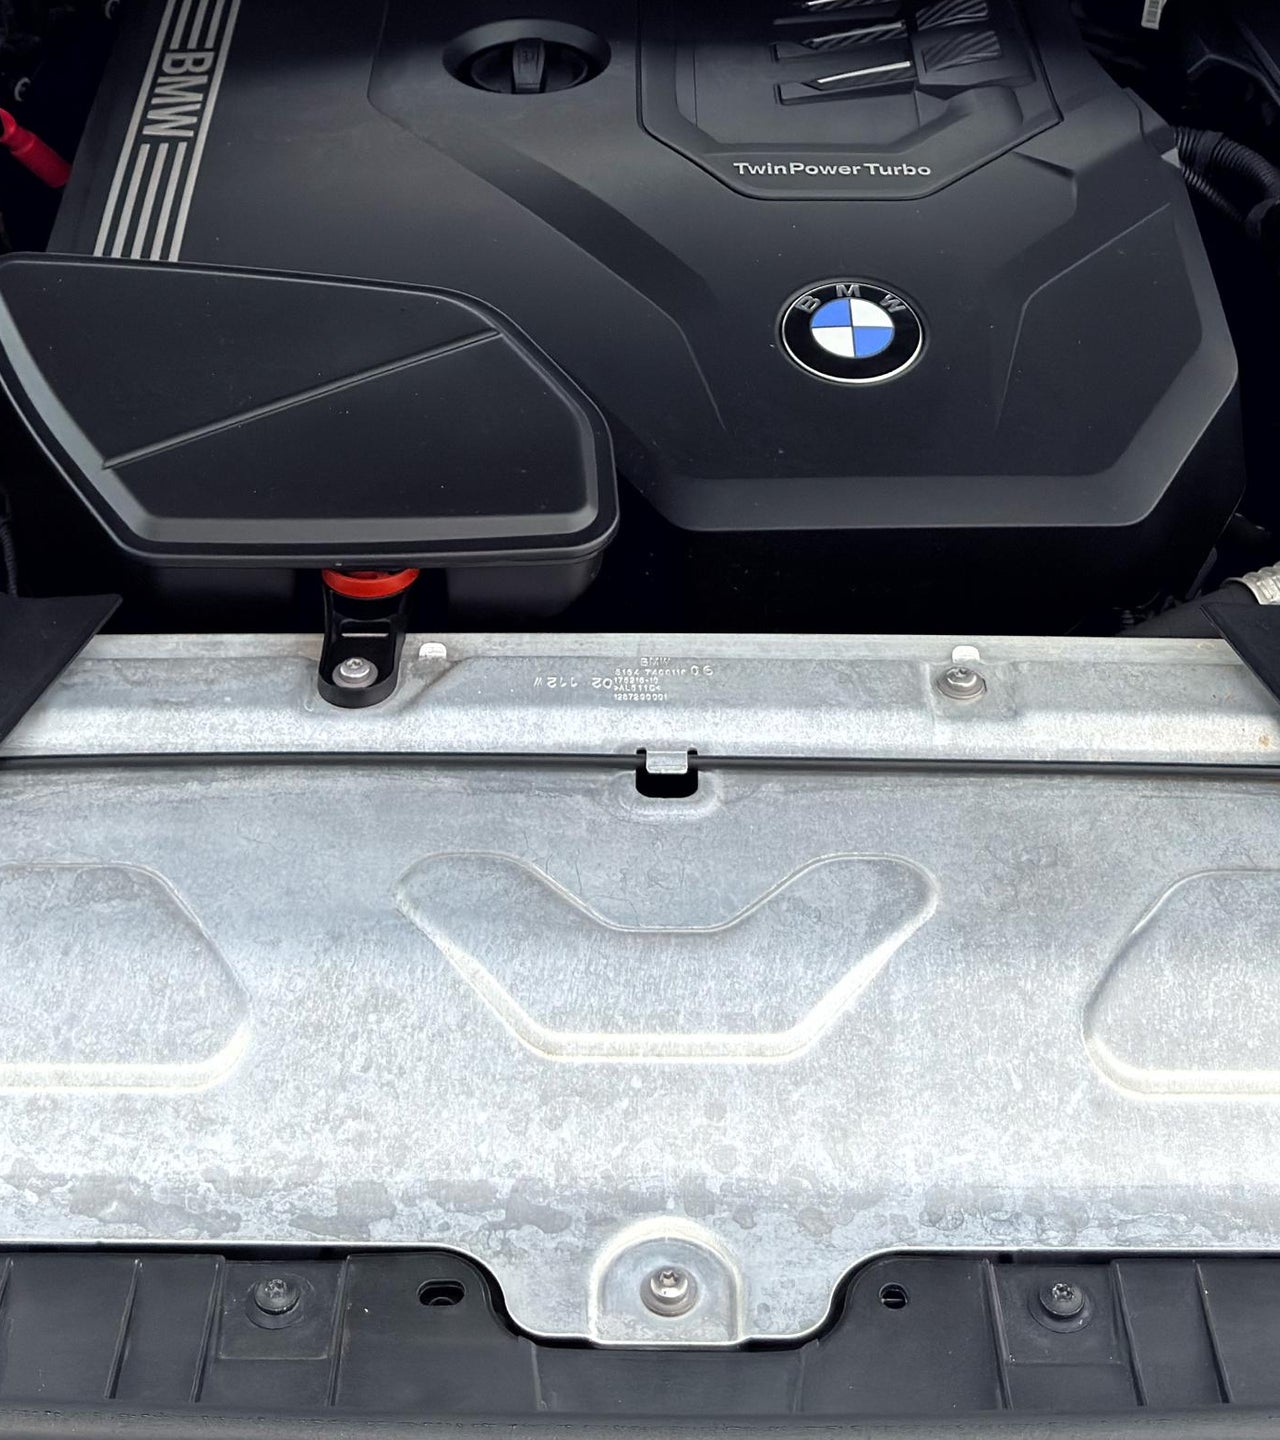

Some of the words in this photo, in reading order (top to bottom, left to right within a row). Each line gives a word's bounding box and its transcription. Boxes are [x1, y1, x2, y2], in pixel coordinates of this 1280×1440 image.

[142, 51, 215, 137] BMW
[863, 163, 932, 176] Turbo
[795, 283, 907, 315] BMW
